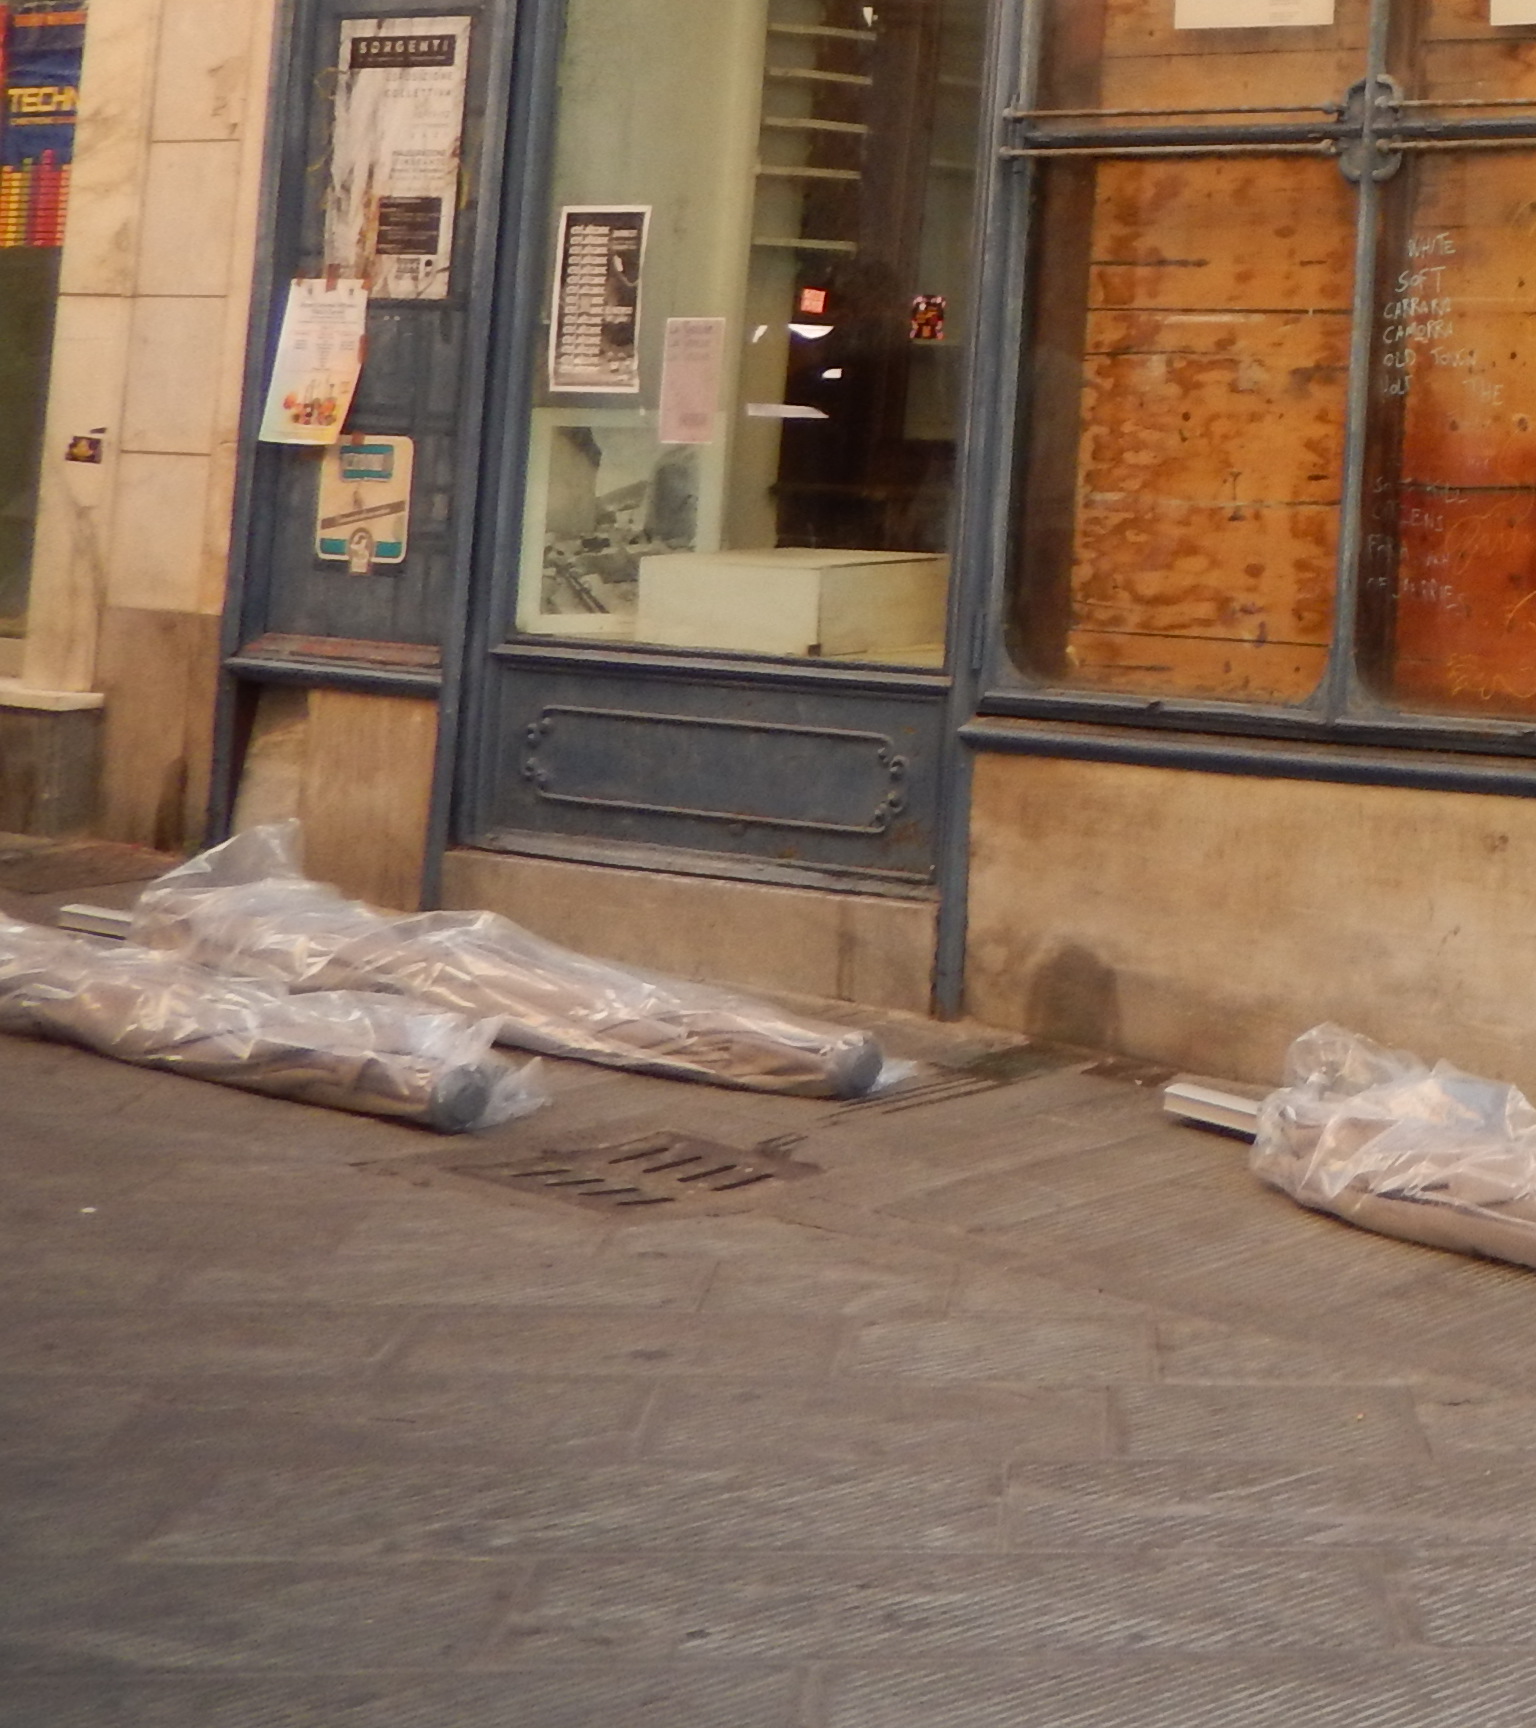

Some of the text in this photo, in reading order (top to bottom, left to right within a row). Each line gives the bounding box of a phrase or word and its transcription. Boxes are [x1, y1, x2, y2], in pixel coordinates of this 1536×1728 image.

[359, 39, 449, 54] SORGENTI
[1407, 232, 1456, 258] WHITE
[1395, 266, 1446, 293] SOFT
[1382, 348, 1416, 368] OLD
